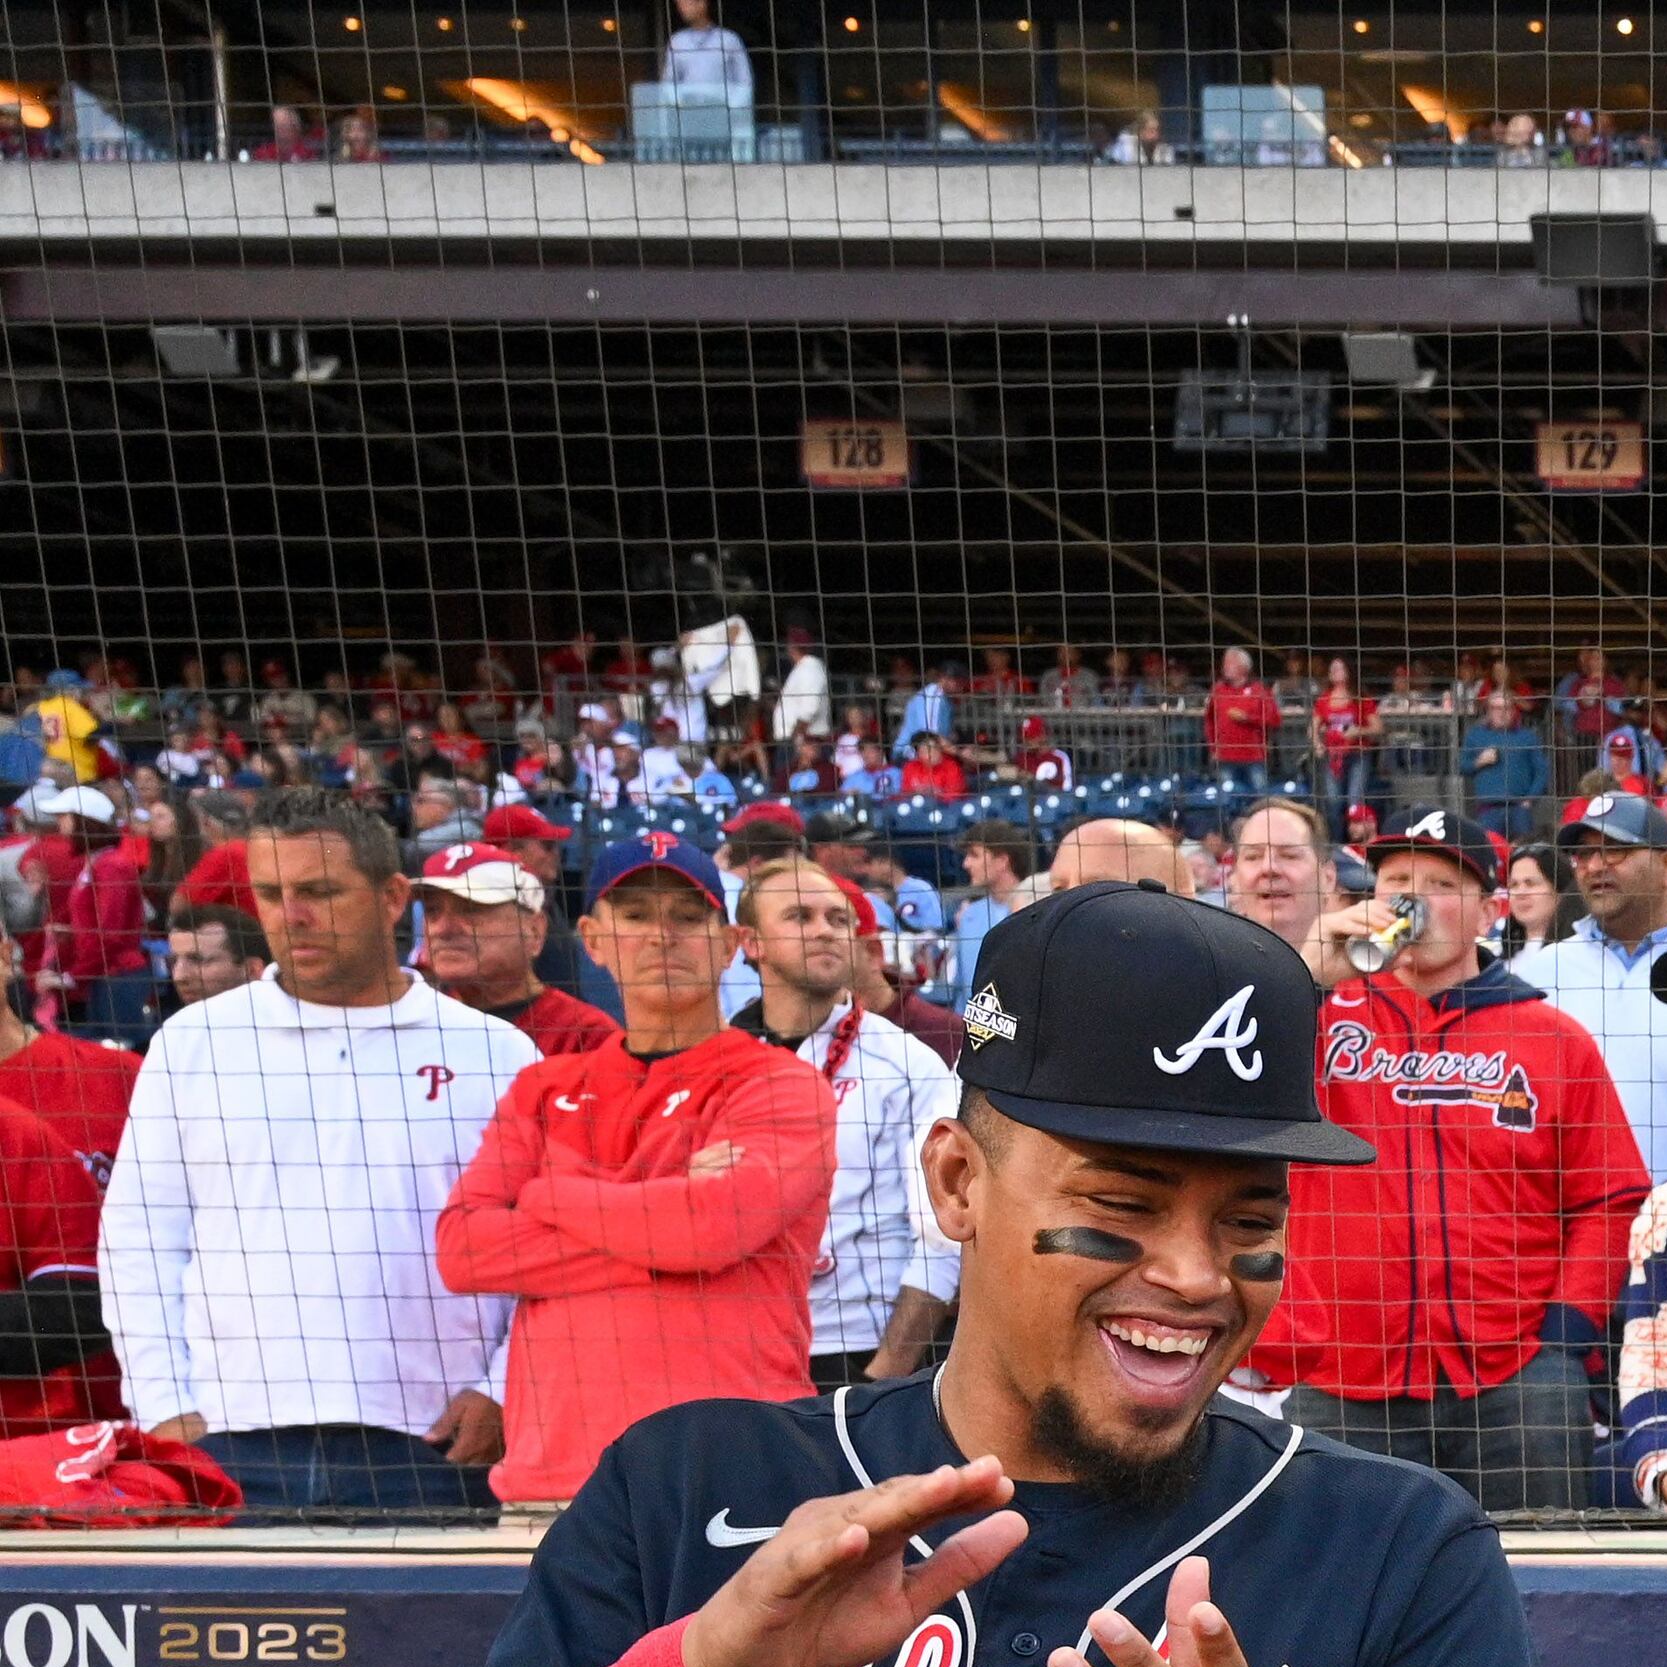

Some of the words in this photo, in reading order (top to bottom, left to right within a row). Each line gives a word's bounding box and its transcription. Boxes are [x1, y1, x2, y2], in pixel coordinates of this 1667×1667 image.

[827, 428, 883, 468] 128
[1562, 430, 1617, 470] 129
[1153, 985, 1263, 1081] A
[1324, 1020, 1507, 1087] Braves
[416, 1065, 454, 1100] P
[159, 1622, 348, 1661] 2023
